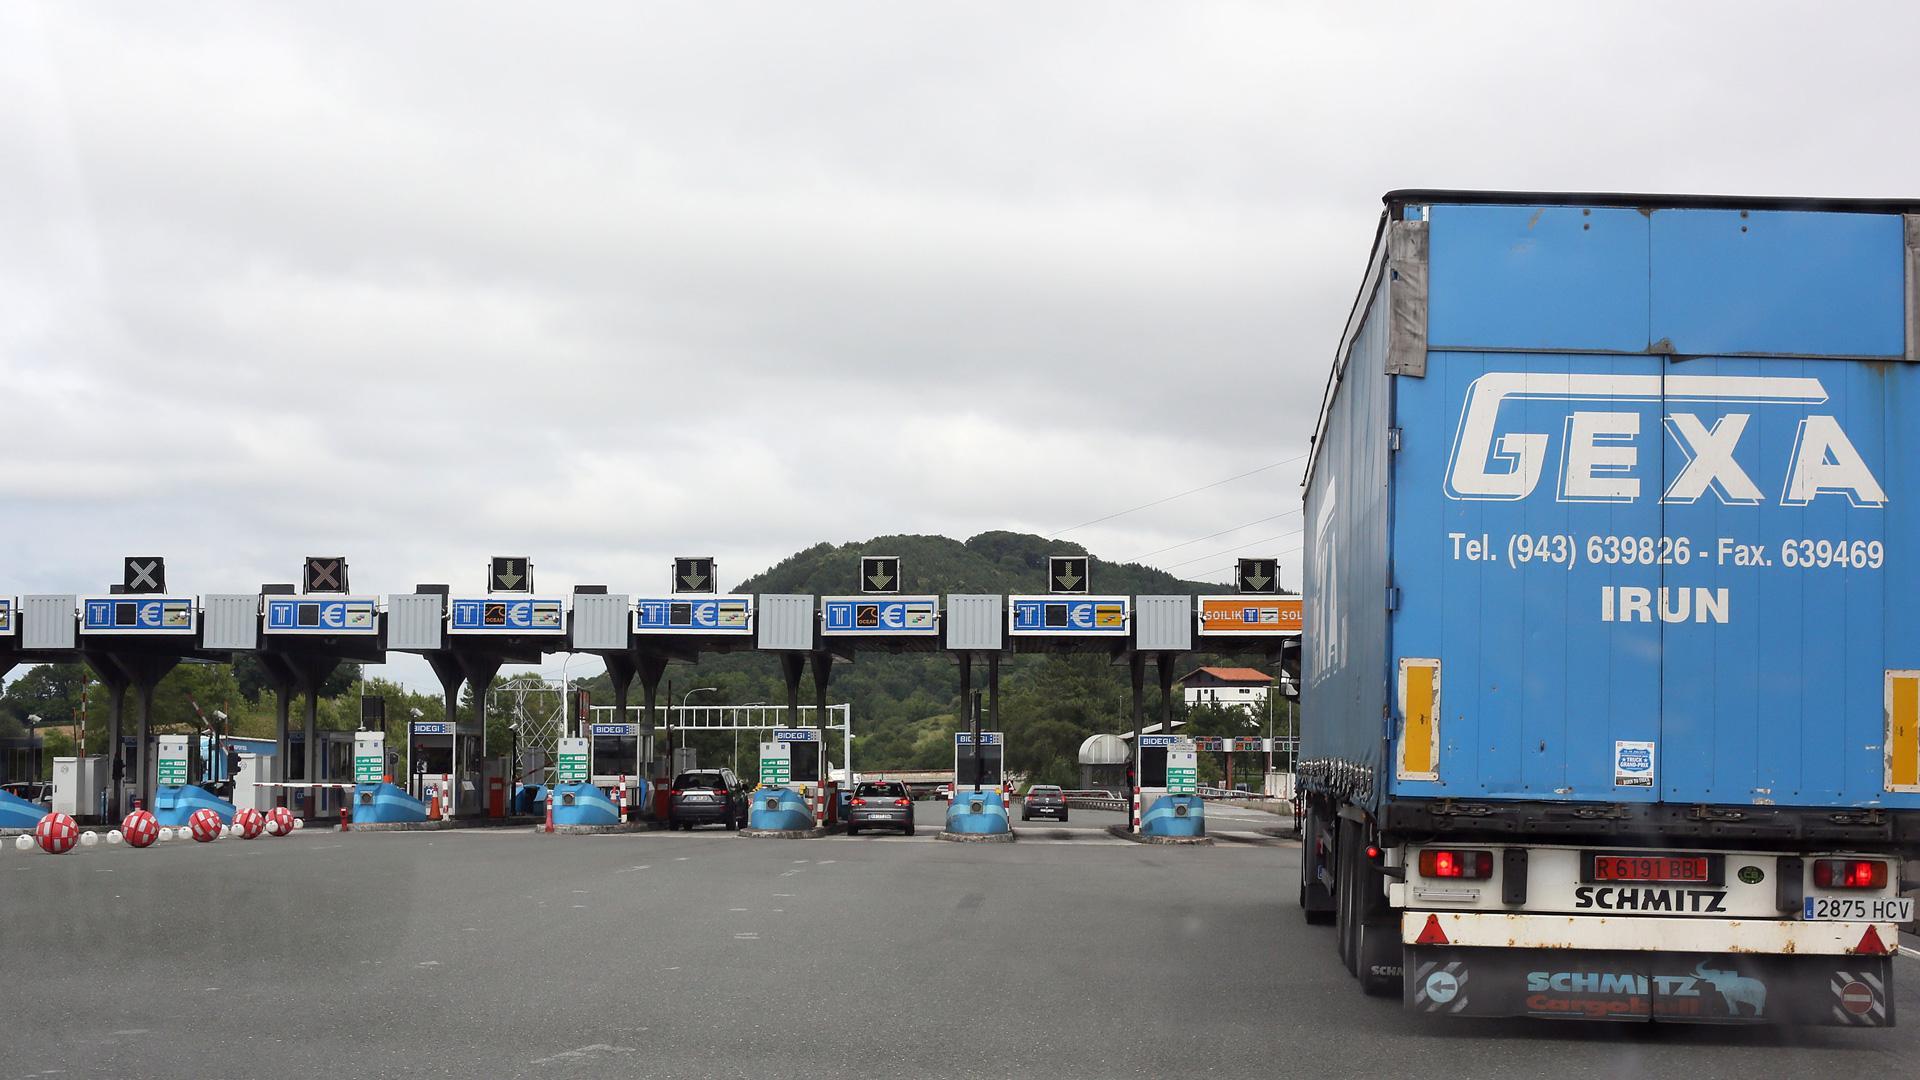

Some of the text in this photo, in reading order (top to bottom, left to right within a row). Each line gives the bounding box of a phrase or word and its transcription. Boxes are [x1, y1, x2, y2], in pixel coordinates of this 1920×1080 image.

[1442, 372, 1889, 508] GEXA
[1448, 532, 1497, 561] Tel.
[1508, 534, 1577, 570] (943)
[1586, 535, 1691, 565] 639826
[1718, 538, 1772, 567] Fax.
[1781, 539, 1884, 569] 639469
[1205, 611, 1242, 620] SOILIK
[1601, 586, 1729, 624] IRUN
[1597, 860, 1706, 878] R 6191 BBL
[1575, 886, 1728, 912] SCHMITZ
[1817, 900, 1866, 918] 2875
[1873, 901, 1909, 919] HCV
[1526, 971, 1700, 996] SCHMITZ
